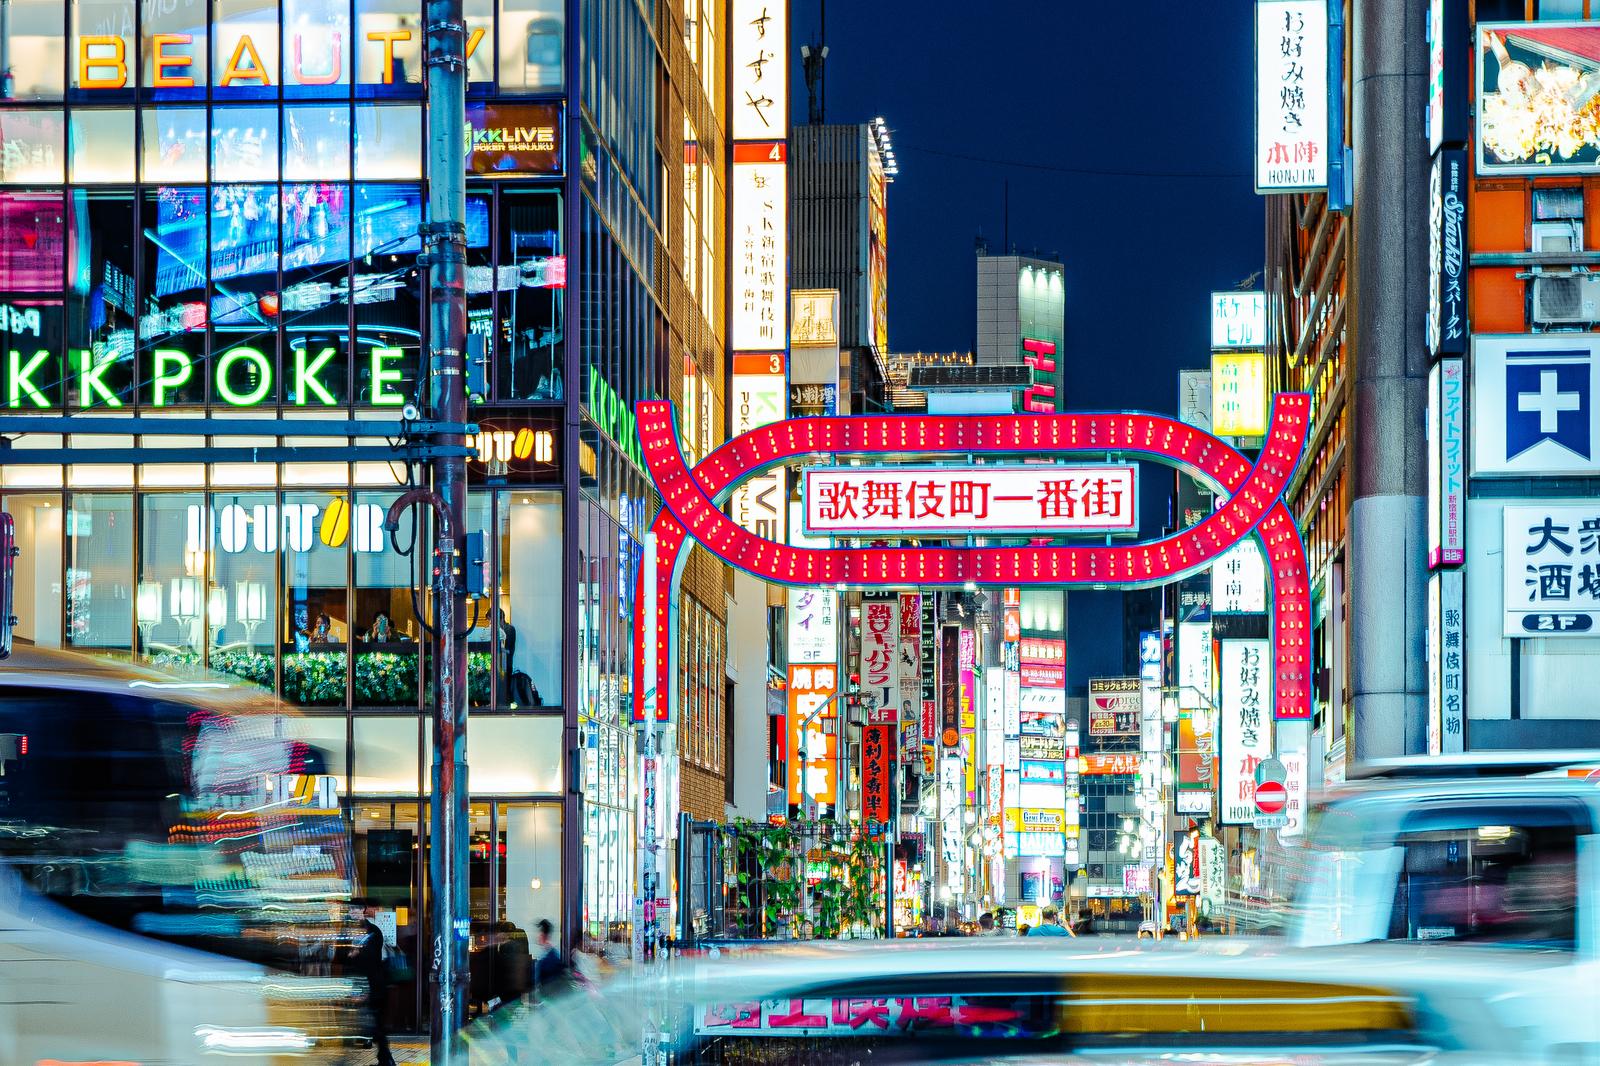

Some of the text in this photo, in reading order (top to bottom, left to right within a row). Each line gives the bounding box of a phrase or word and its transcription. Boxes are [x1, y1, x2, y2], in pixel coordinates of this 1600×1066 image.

[1279, 10, 1306, 134] お好み焼き
[473, 126, 554, 143] KKLIVE
[473, 143, 554, 152] POKER SHINJUKU
[768, 142, 781, 161] 4
[1266, 140, 1319, 165] 本陣
[1268, 168, 1316, 184] HONJIN
[1443, 191, 1465, 278] Sparkle
[1445, 279, 1463, 342] スパークル
[768, 354, 781, 373] 3
[790, 385, 835, 404] 小料理
[1444, 380, 1461, 494] ファイトフィット
[817, 478, 1124, 521] 歌舞伎町一番街
[1536, 614, 1578, 631] 2F
[1444, 608, 1462, 736] 歌舞伎町名物
[1239, 646, 1260, 748] お好み焼き
[870, 711, 889, 722] 4F
